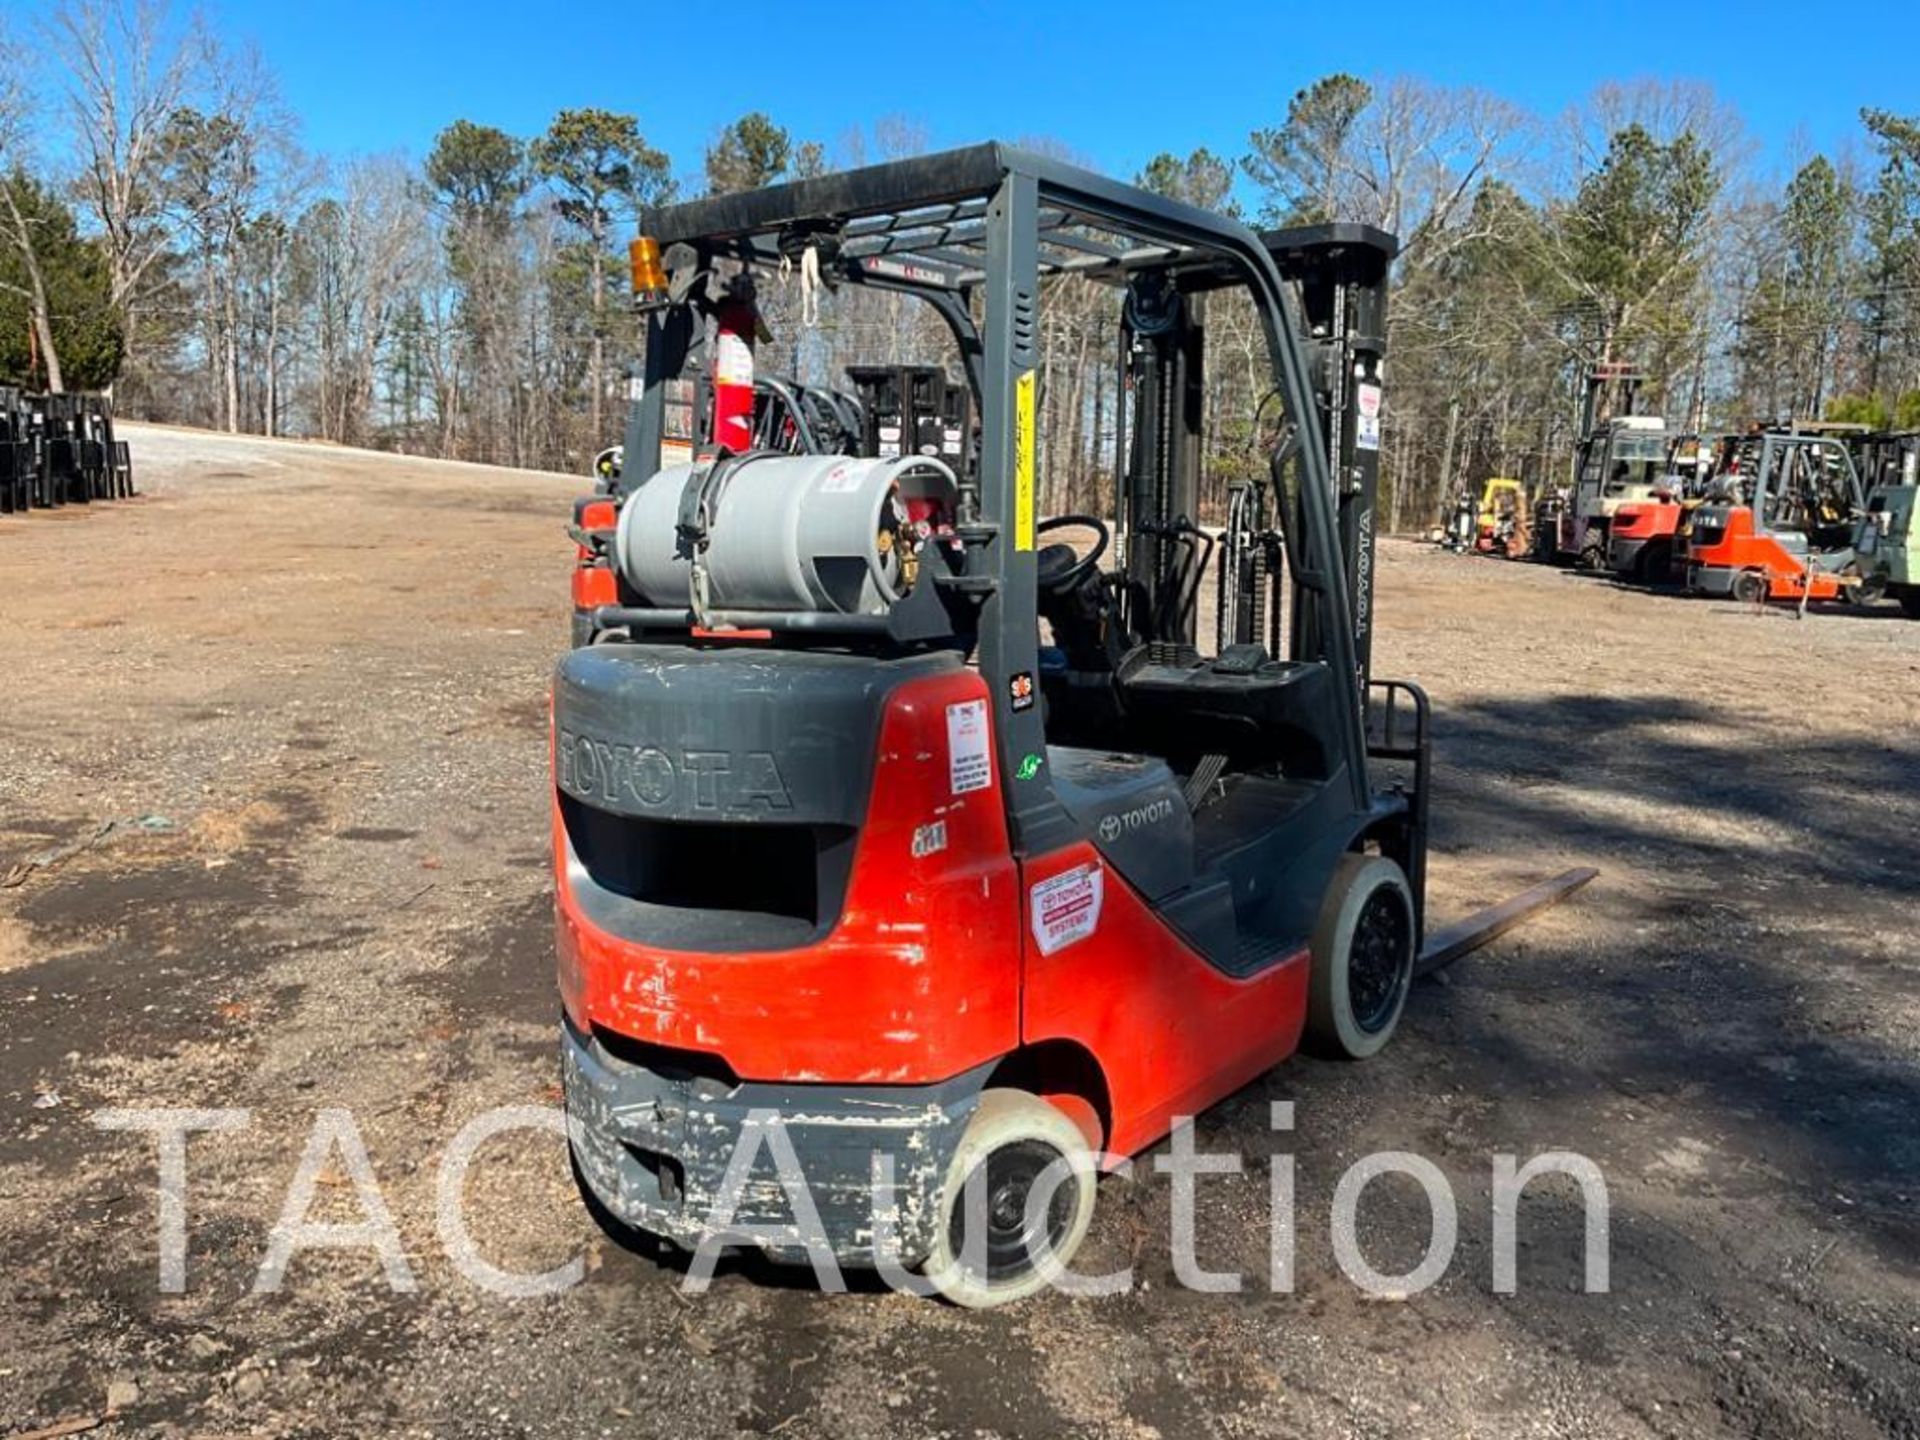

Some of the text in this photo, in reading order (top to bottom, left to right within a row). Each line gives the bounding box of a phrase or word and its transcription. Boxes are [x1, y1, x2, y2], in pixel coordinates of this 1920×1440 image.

[1355, 508, 1372, 640] TOYOTA
[559, 731, 794, 810] TOYOTA
[1121, 799, 1174, 829] TOYOTA
